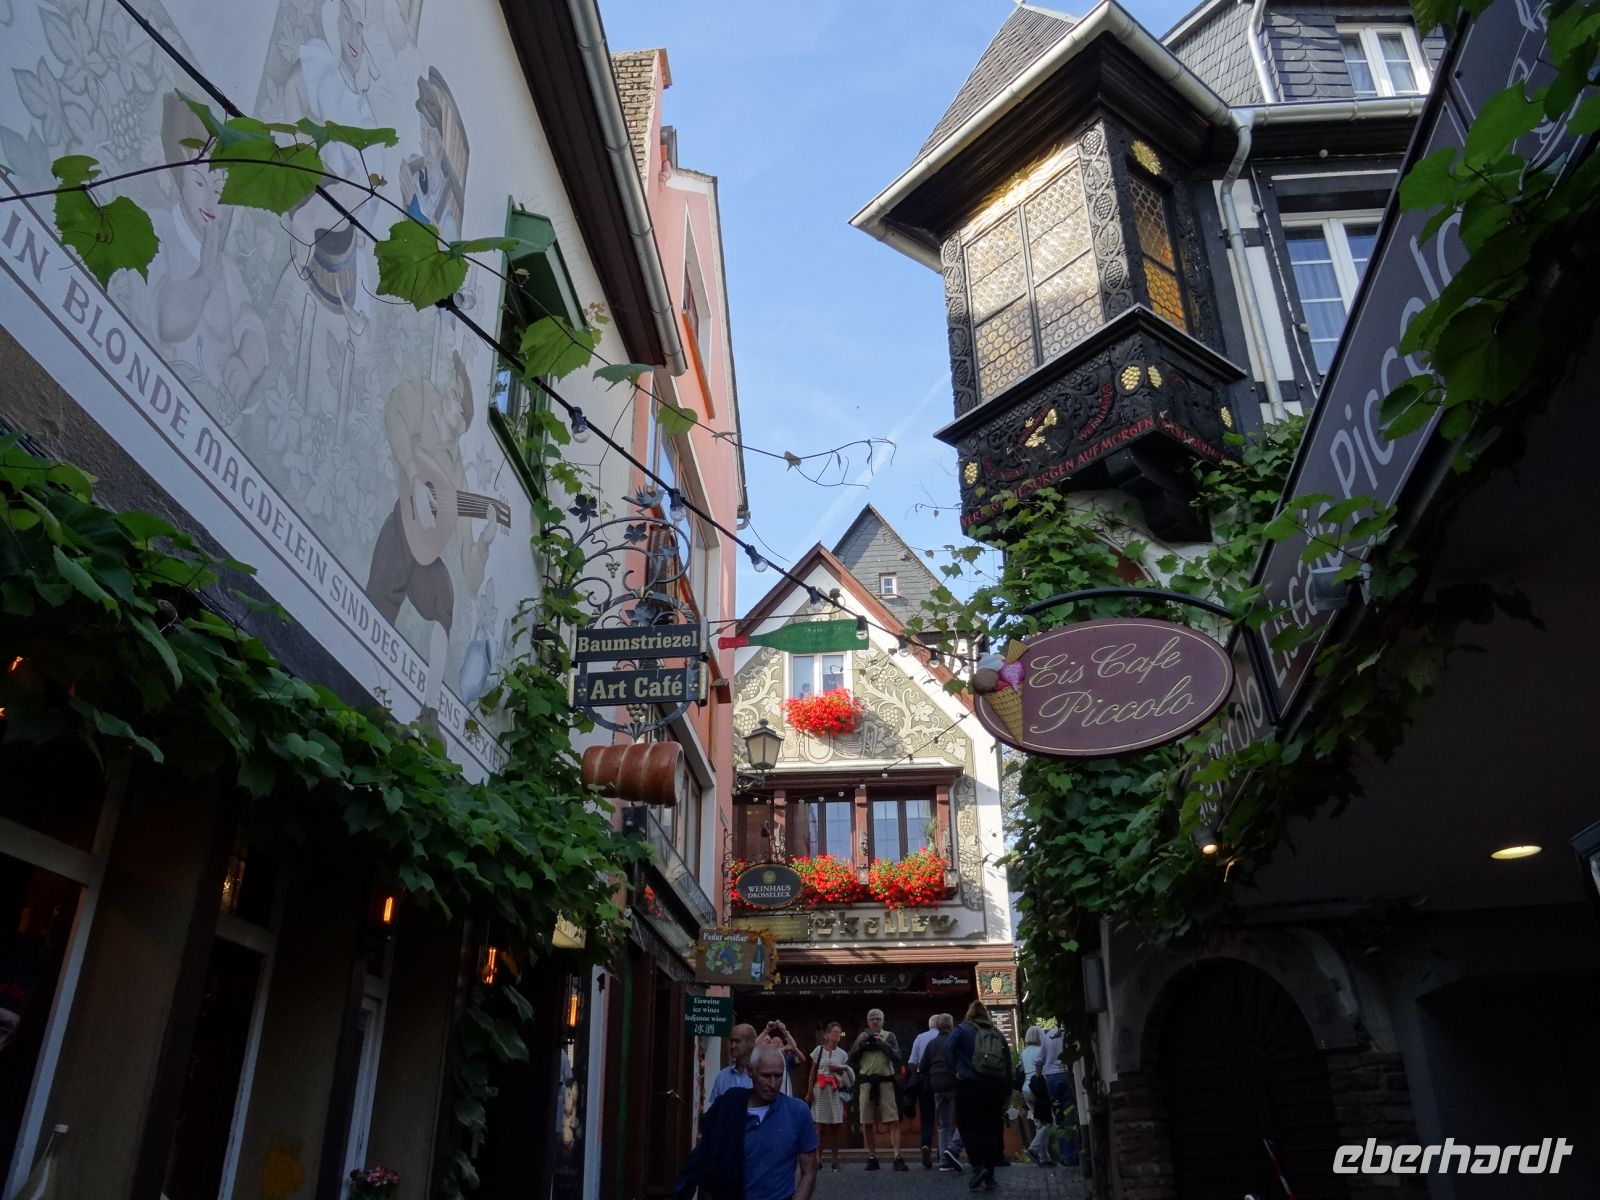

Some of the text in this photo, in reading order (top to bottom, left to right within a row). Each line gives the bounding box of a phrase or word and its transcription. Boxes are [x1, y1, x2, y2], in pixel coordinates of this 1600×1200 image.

[1076, 444, 1102, 467] AUF
[1100, 416, 1154, 452] MORGEN
[62, 276, 191, 439] BLONDE
[195, 427, 328, 586] MAGDELEIN
[330, 574, 369, 632] SIND
[371, 617, 400, 665] DES
[577, 630, 698, 653] Baumstriezel
[1029, 653, 1085, 688] Eis
[590, 674, 683, 700] Art Café
[1029, 675, 1194, 733] Piccolo
[748, 884, 791, 893] WEINHAUS
[748, 890, 791, 899] DROSSELECK
[784, 974, 845, 985] TAURANT
[692, 1005, 702, 1013] ice
